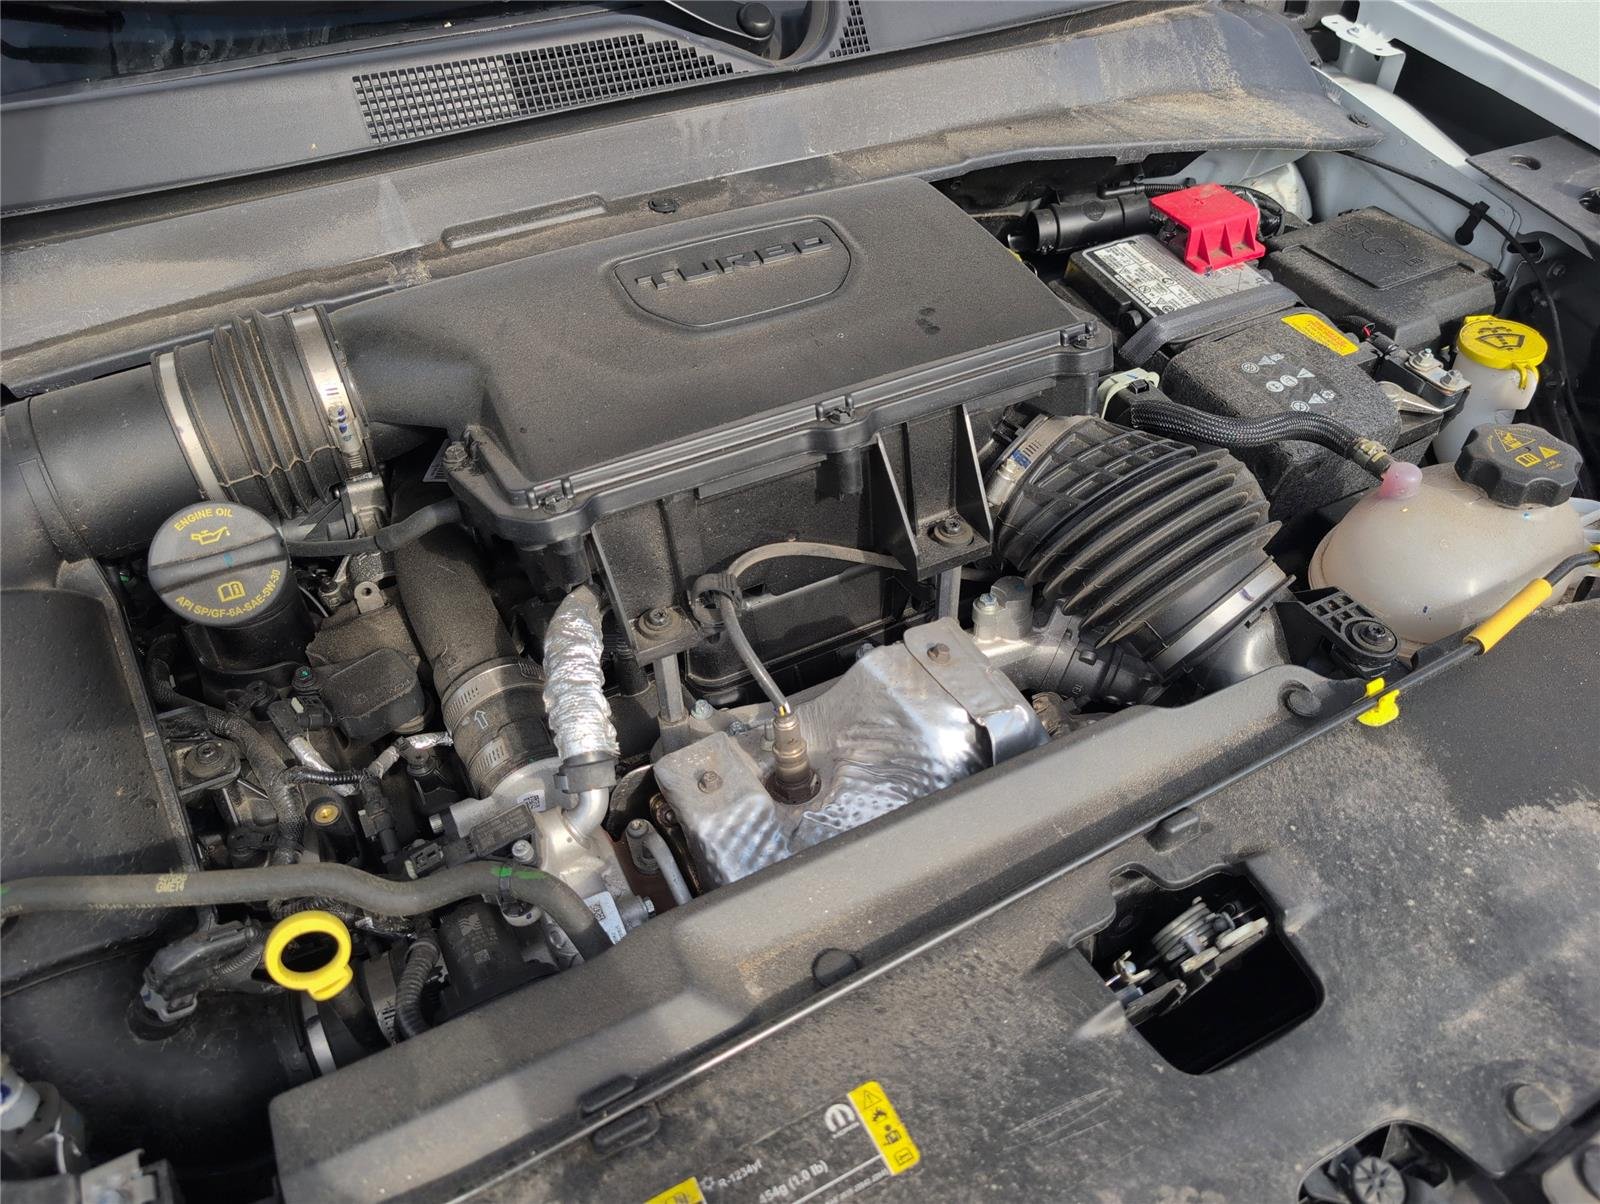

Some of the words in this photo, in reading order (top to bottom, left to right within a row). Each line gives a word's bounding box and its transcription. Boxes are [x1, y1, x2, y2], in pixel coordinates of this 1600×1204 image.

[635, 235, 833, 290] TURBO
[174, 508, 213, 531] ENGINE
[215, 508, 233, 518] OIL
[175, 596, 193, 612] API
[718, 1157, 762, 1187] R-1234yf
[760, 1184, 789, 1203] 454g
[789, 1169, 811, 1191] (1.0
[810, 1160, 828, 1176] lb)
